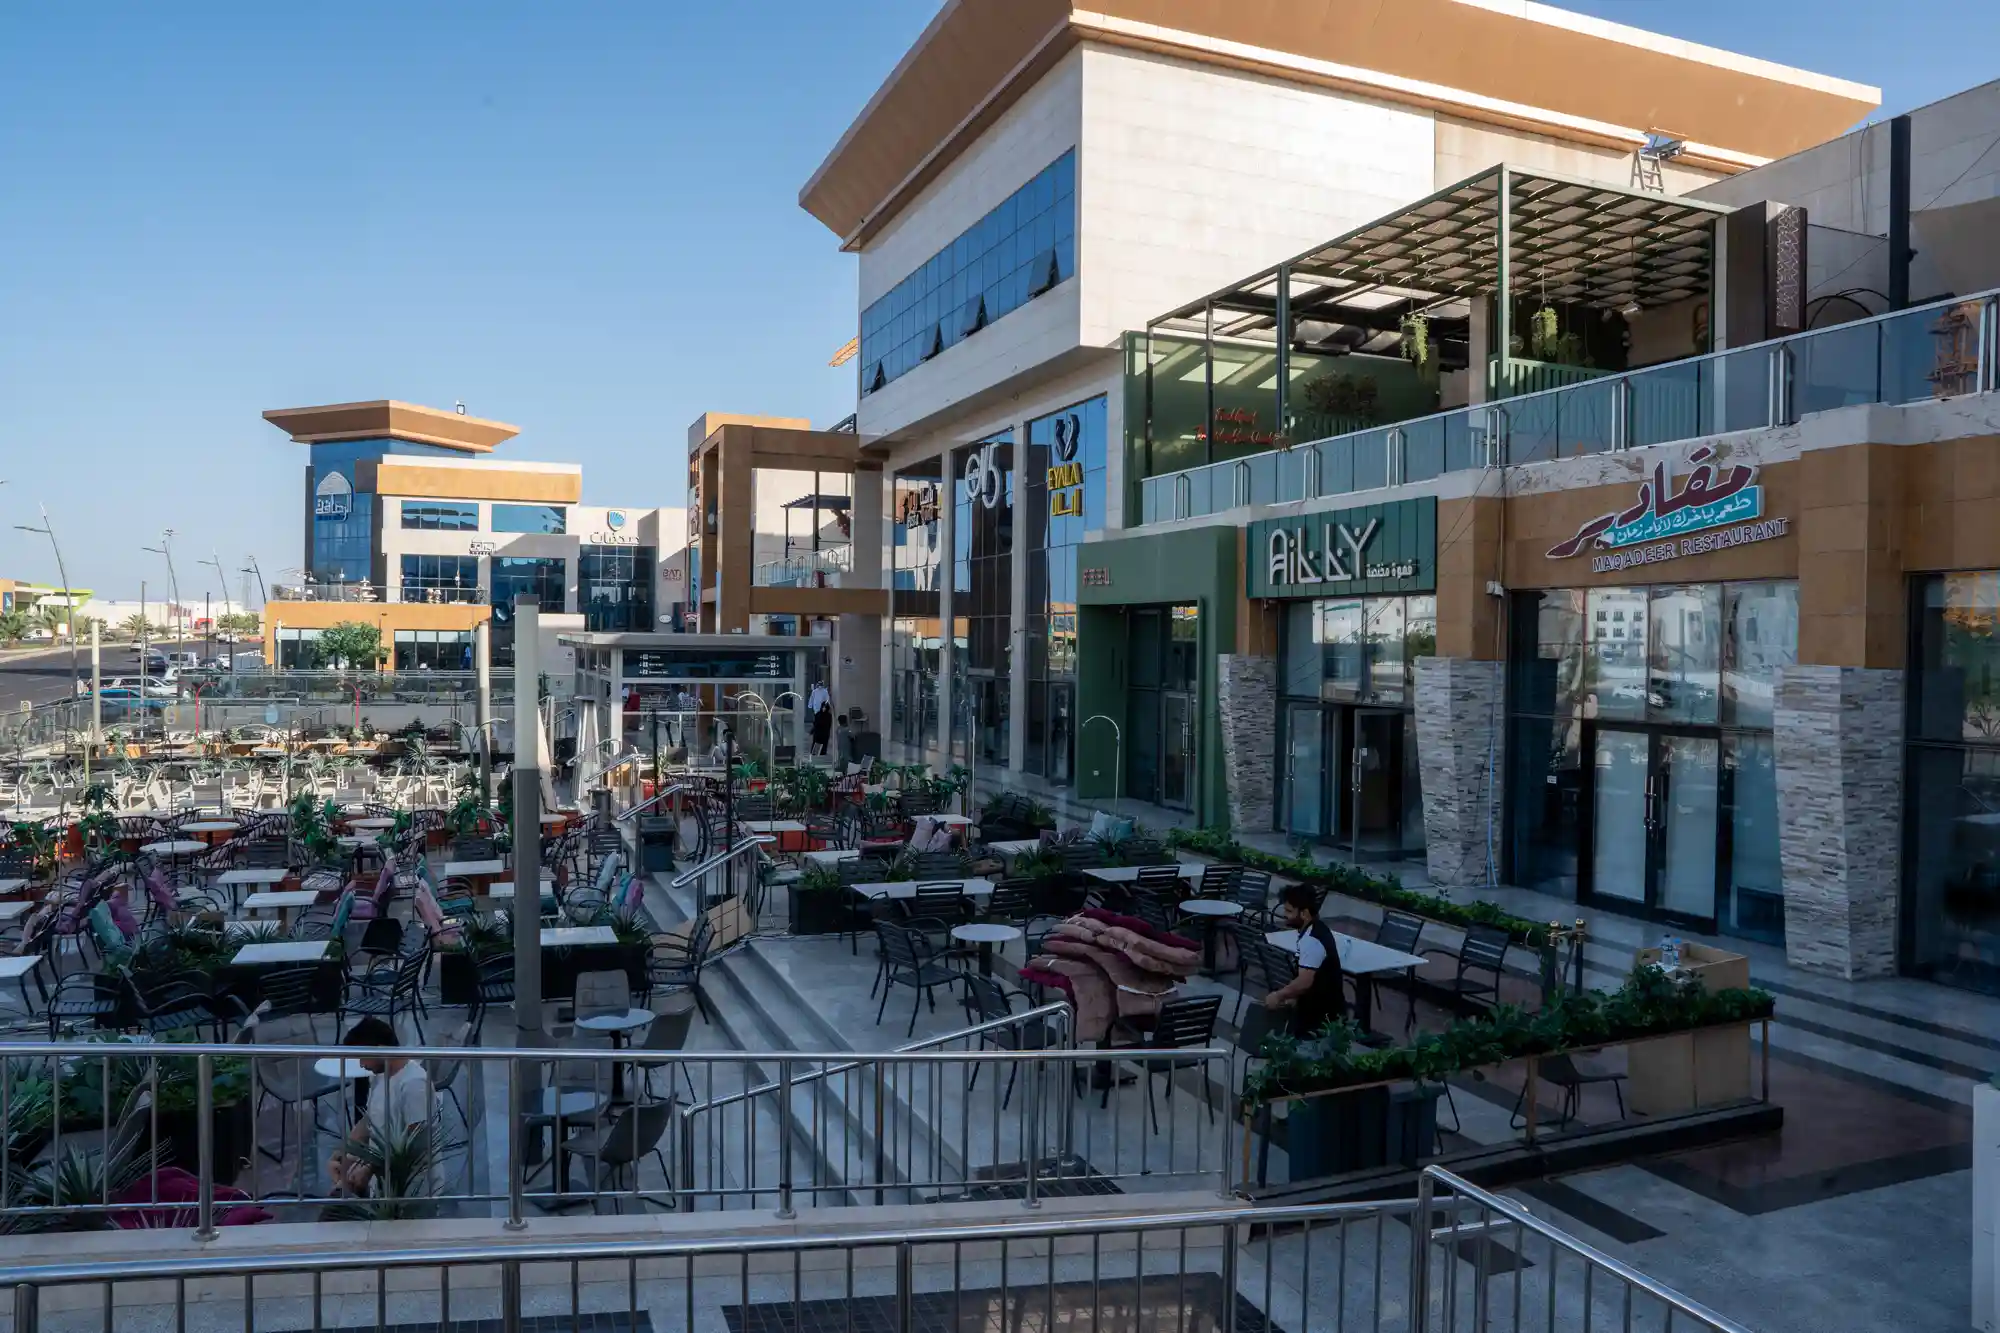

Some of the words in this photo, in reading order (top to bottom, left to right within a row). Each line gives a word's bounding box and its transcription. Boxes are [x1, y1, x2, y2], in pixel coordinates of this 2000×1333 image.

[1048, 463, 1081, 490] EYALA
[1592, 542, 1676, 573] MAQADEER
[1680, 516, 1788, 555] RESTAURANT
